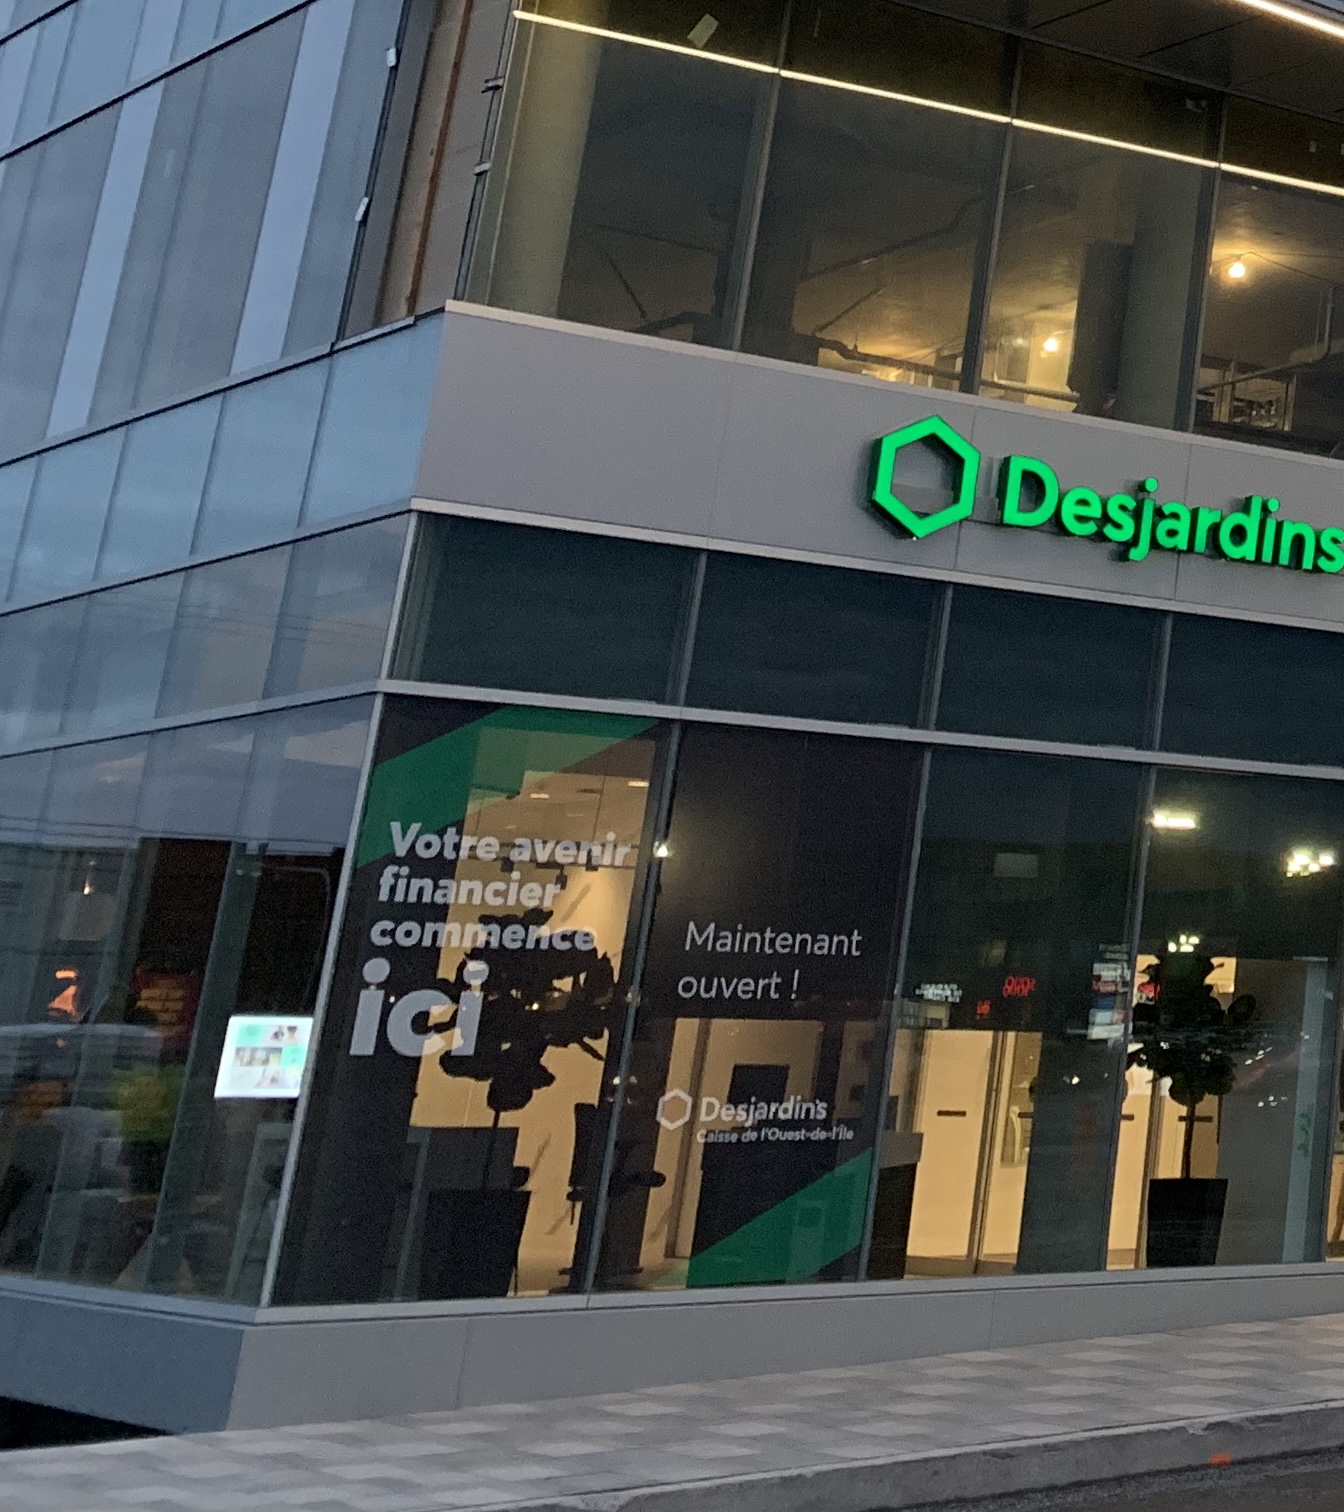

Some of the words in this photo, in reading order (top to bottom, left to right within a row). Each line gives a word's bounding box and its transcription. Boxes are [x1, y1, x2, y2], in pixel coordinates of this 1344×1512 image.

[388, 820, 502, 862] Votre
[508, 830, 632, 867] avenir
[377, 864, 563, 907] financier
[369, 919, 598, 951] commence
[684, 920, 863, 957] Maintenant
[677, 970, 782, 1000] ouvert
[349, 956, 491, 1058] ici
[699, 1094, 828, 1128] Desjardins
[695, 1128, 740, 1145] Caisse
[740, 1128, 757, 1143] de
